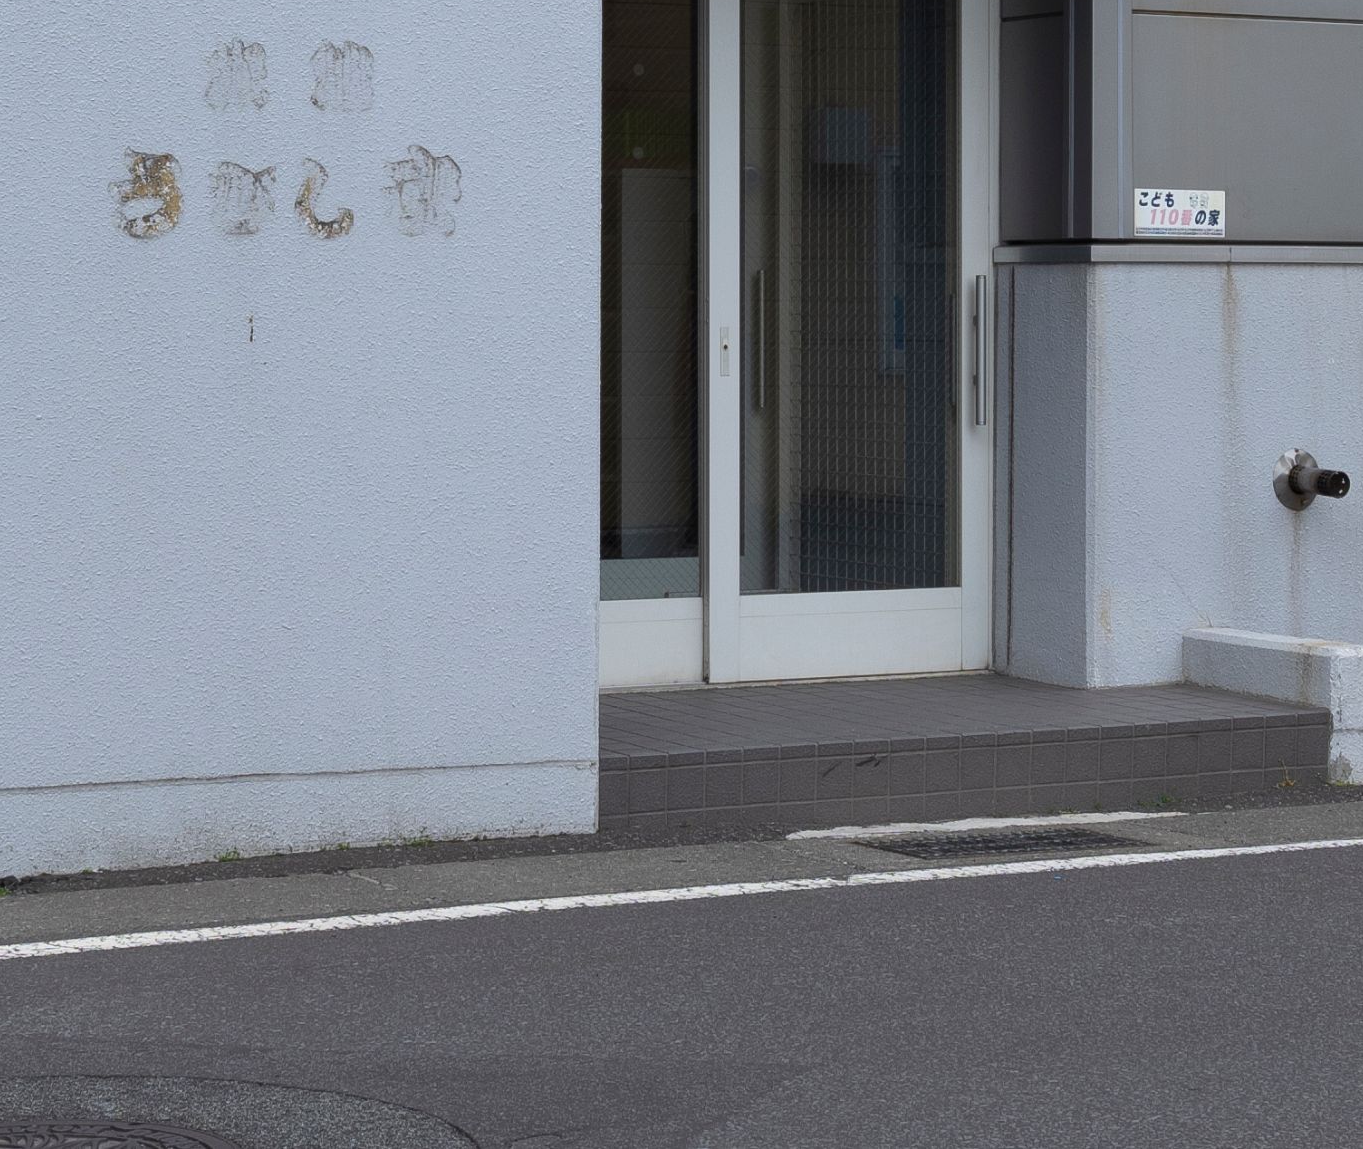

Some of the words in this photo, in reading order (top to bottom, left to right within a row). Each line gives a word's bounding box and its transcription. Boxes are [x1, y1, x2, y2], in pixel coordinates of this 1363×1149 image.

[1139, 192, 1175, 207] こども
[1151, 209, 1220, 226] 110番の家
